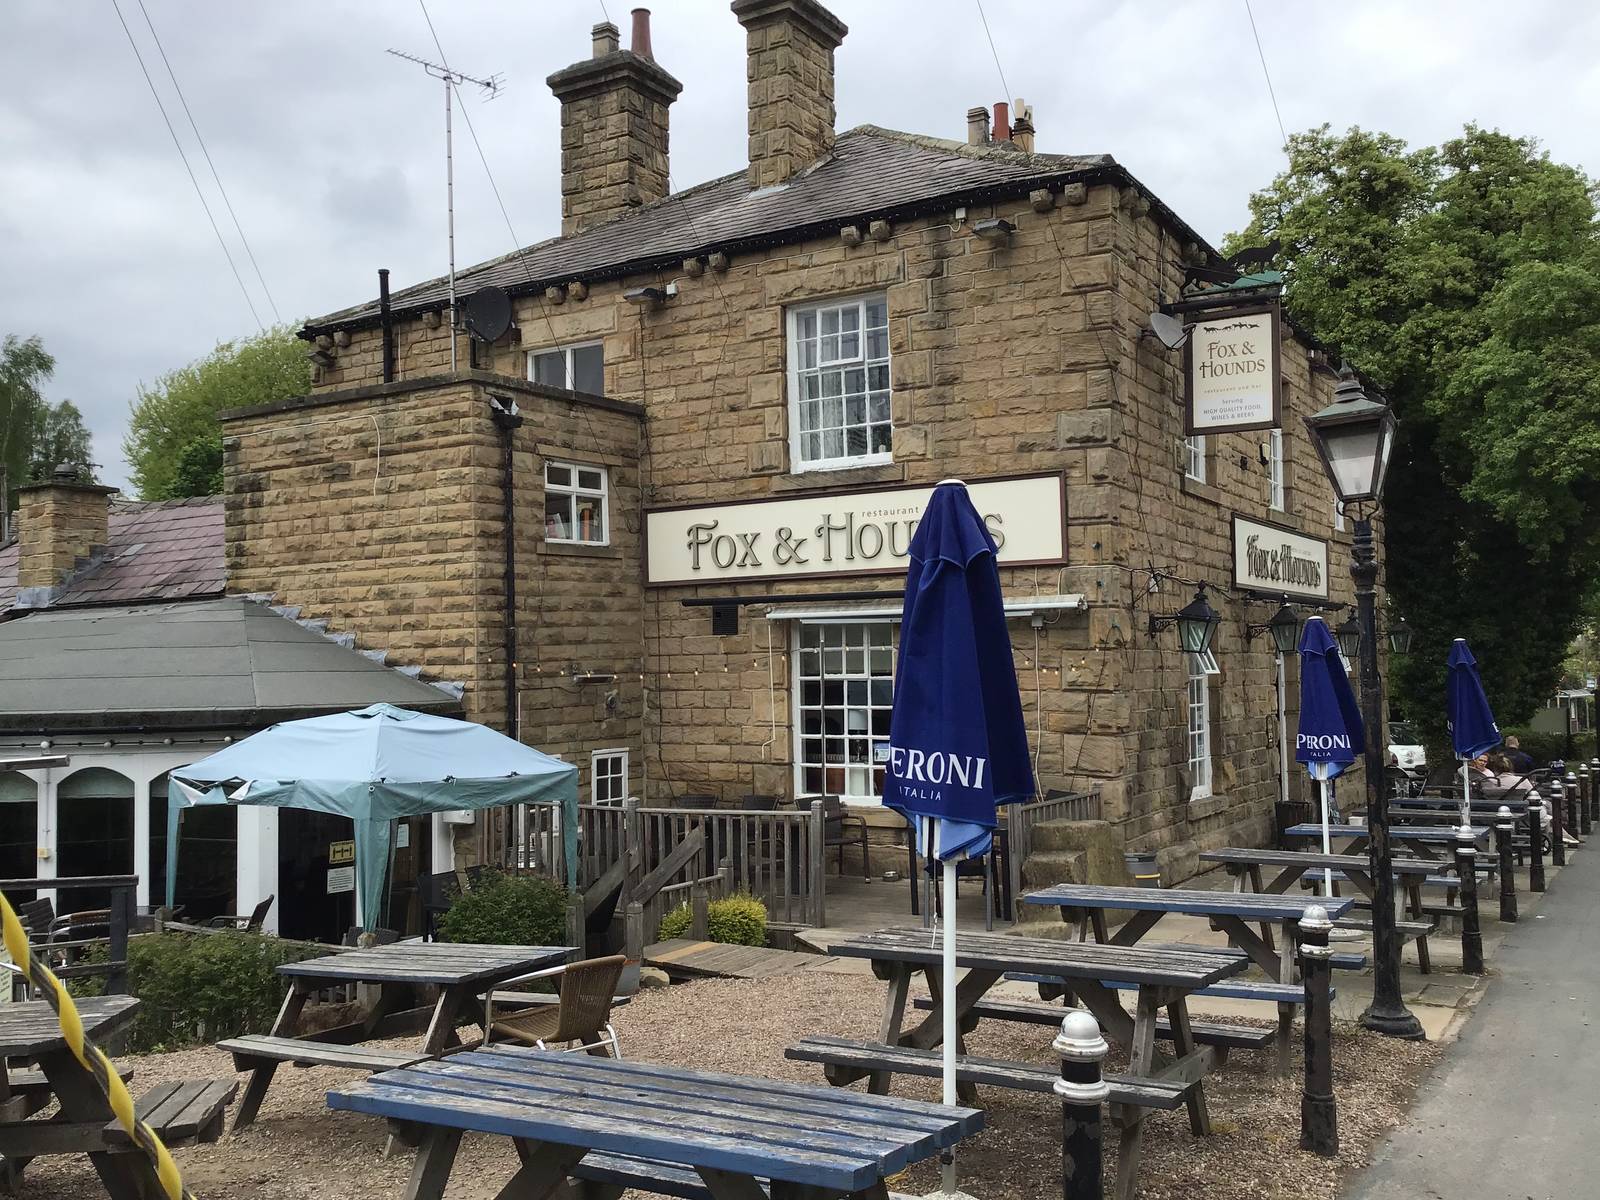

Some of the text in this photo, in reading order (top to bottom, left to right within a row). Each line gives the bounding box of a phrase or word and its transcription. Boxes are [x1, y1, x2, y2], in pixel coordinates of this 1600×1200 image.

[1207, 340, 1256, 359] FOX &
[1199, 359, 1265, 378] HOUNDS
[861, 506, 920, 518] restaurant
[687, 511, 1005, 569] FOX & HOUS
[889, 746, 987, 790] ERONI
